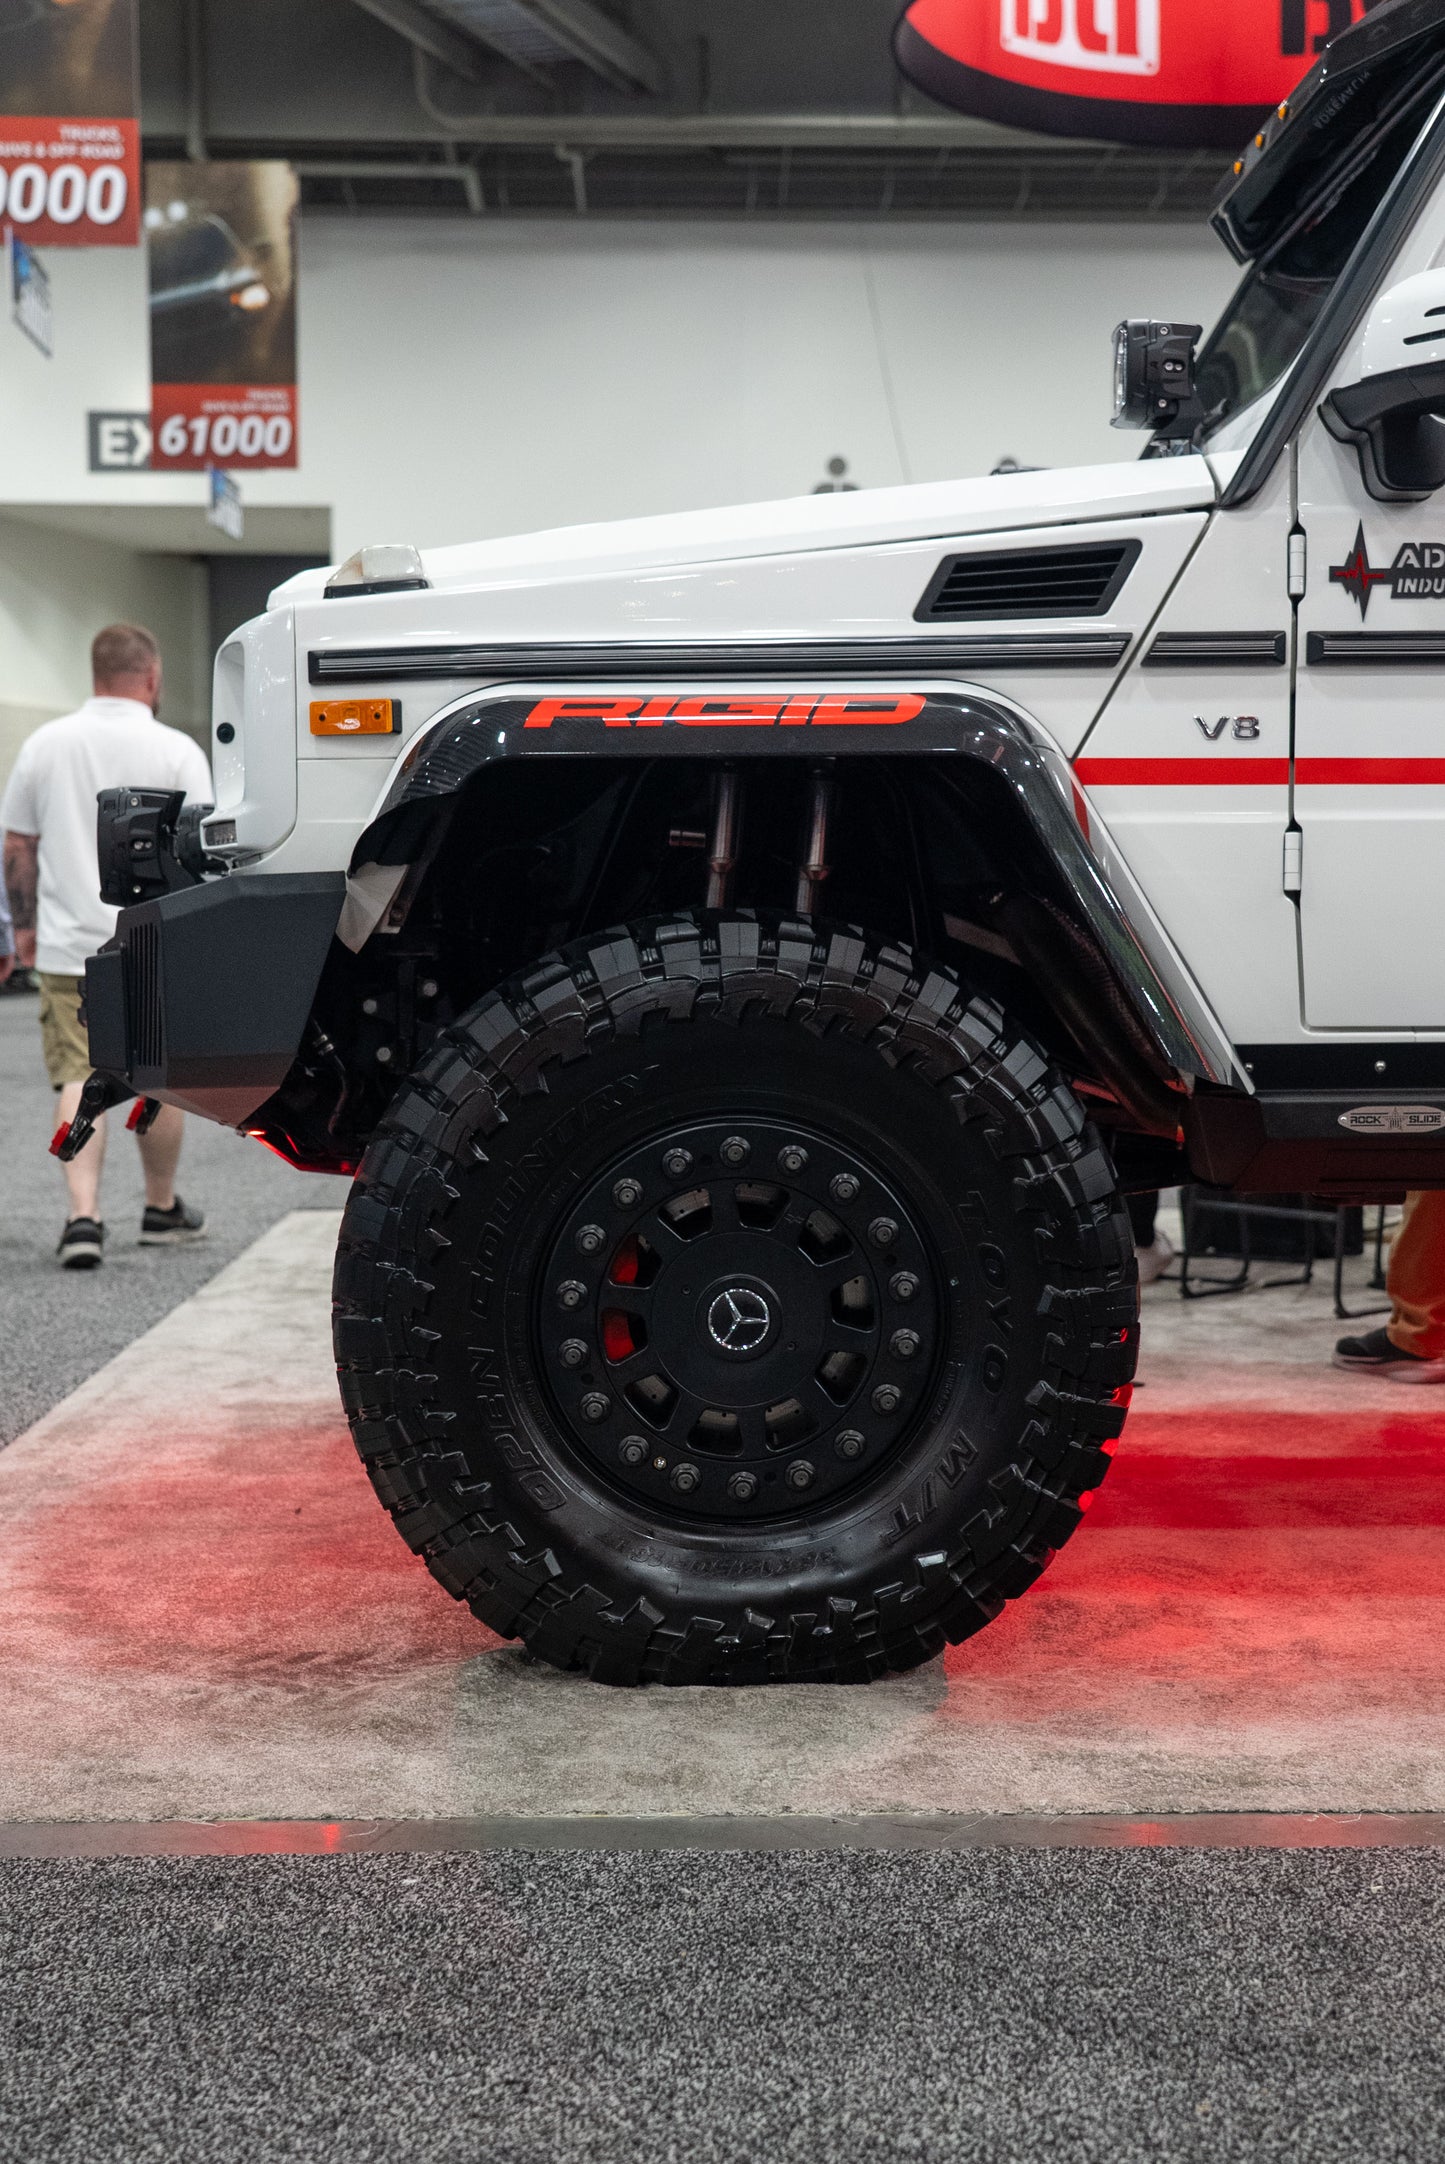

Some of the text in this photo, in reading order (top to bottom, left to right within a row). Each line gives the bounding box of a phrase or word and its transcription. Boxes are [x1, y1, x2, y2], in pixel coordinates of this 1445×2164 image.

[0, 163, 128, 225] 000
[159, 414, 292, 457] 61000
[523, 693, 927, 728] RIGID
[1193, 716, 1260, 740] V8
[1350, 1114, 1442, 1124] ROCK SLIDE
[469, 1063, 660, 1320] COUNTRY
[958, 1190, 1013, 1395] TOYO
[468, 1346, 568, 1511] OPEN
[884, 1428, 979, 1547] M/T
